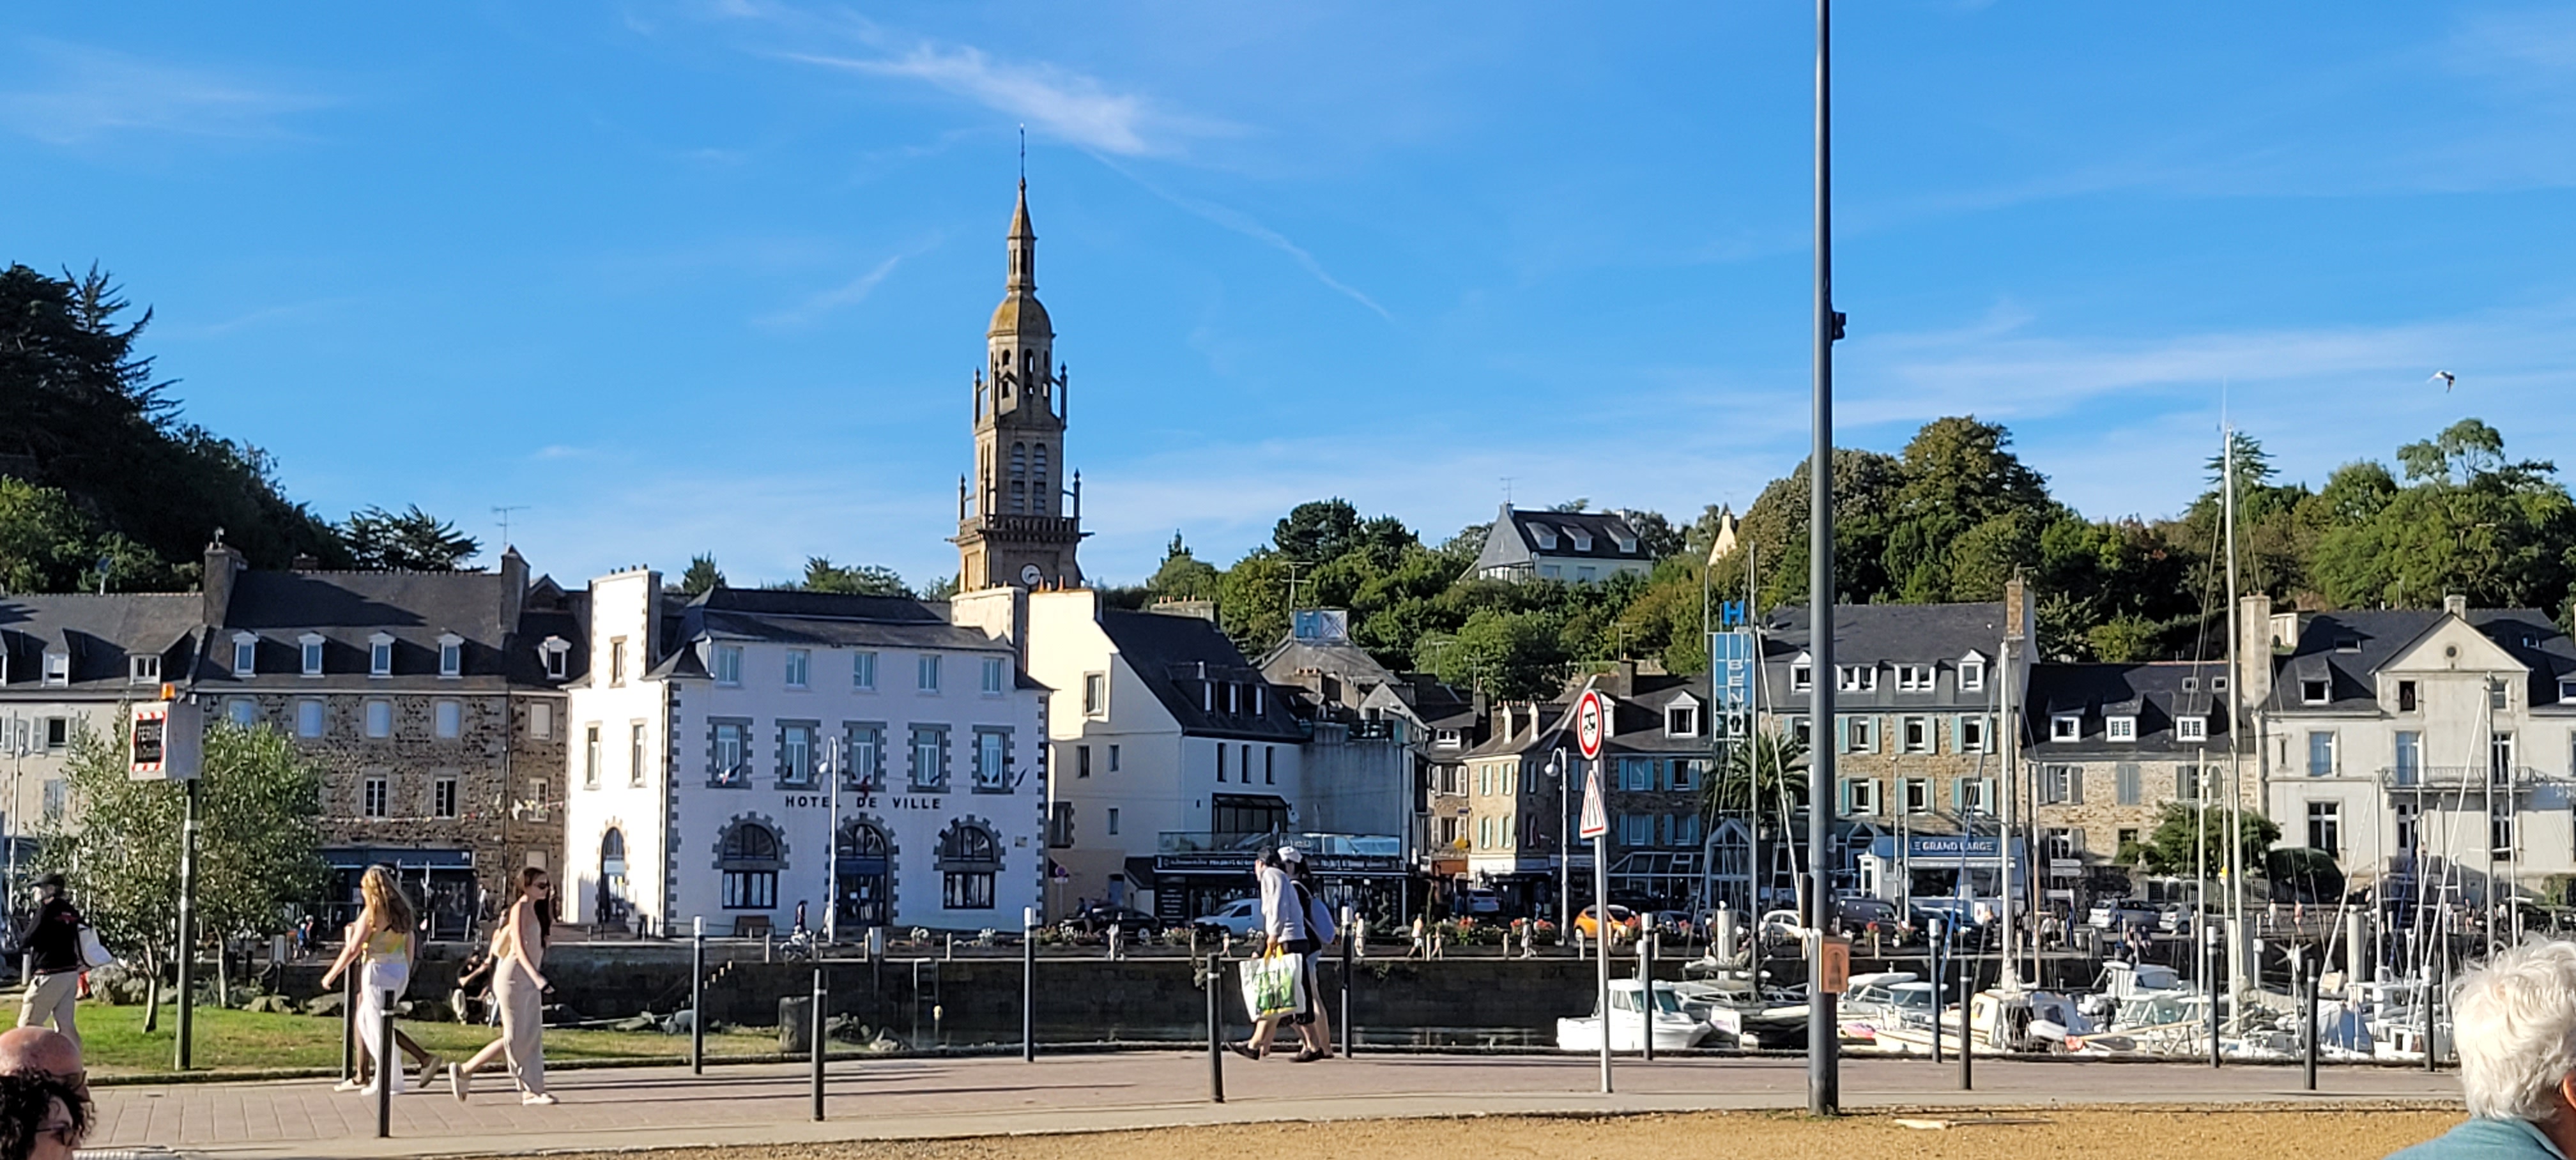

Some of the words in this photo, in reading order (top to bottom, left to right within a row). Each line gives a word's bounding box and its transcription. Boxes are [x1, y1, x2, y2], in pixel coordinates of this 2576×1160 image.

[1722, 600, 1745, 625] H
[857, 797, 877, 808] DE
[893, 798, 941, 809] VILLE
[1909, 841, 1921, 850] LE
[1922, 841, 1958, 851] GRAND
[1959, 841, 1993, 851] LARGE
